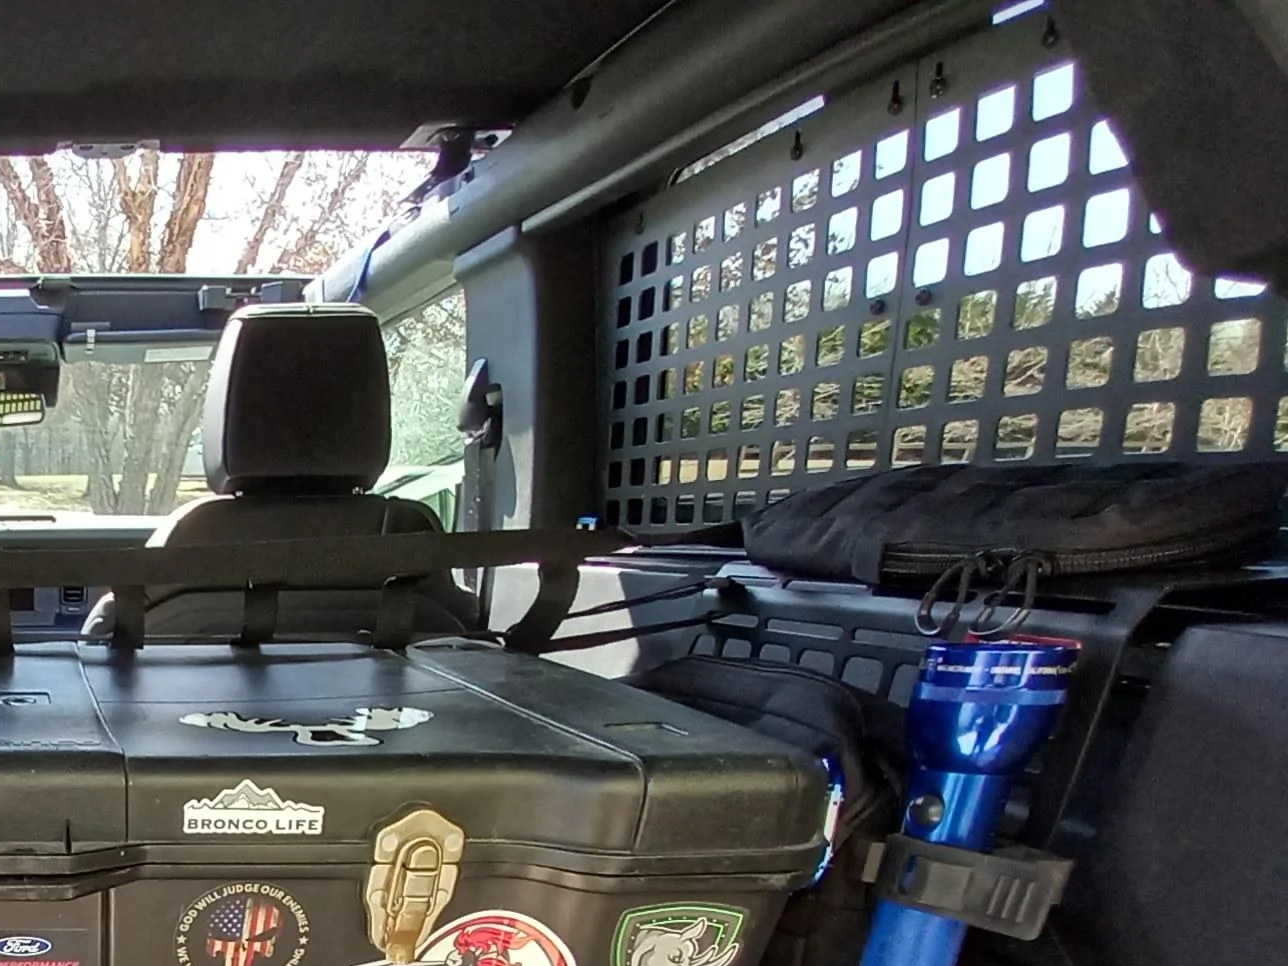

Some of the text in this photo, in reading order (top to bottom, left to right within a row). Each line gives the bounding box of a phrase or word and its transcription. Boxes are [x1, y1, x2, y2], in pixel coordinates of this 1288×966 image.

[187, 818, 319, 830] BRONCO LIFE
[179, 883, 309, 933] GOD WILL JUDGE OUR ENEMIES
[3, 939, 41, 953] Ford
[177, 946, 189, 963] WE
